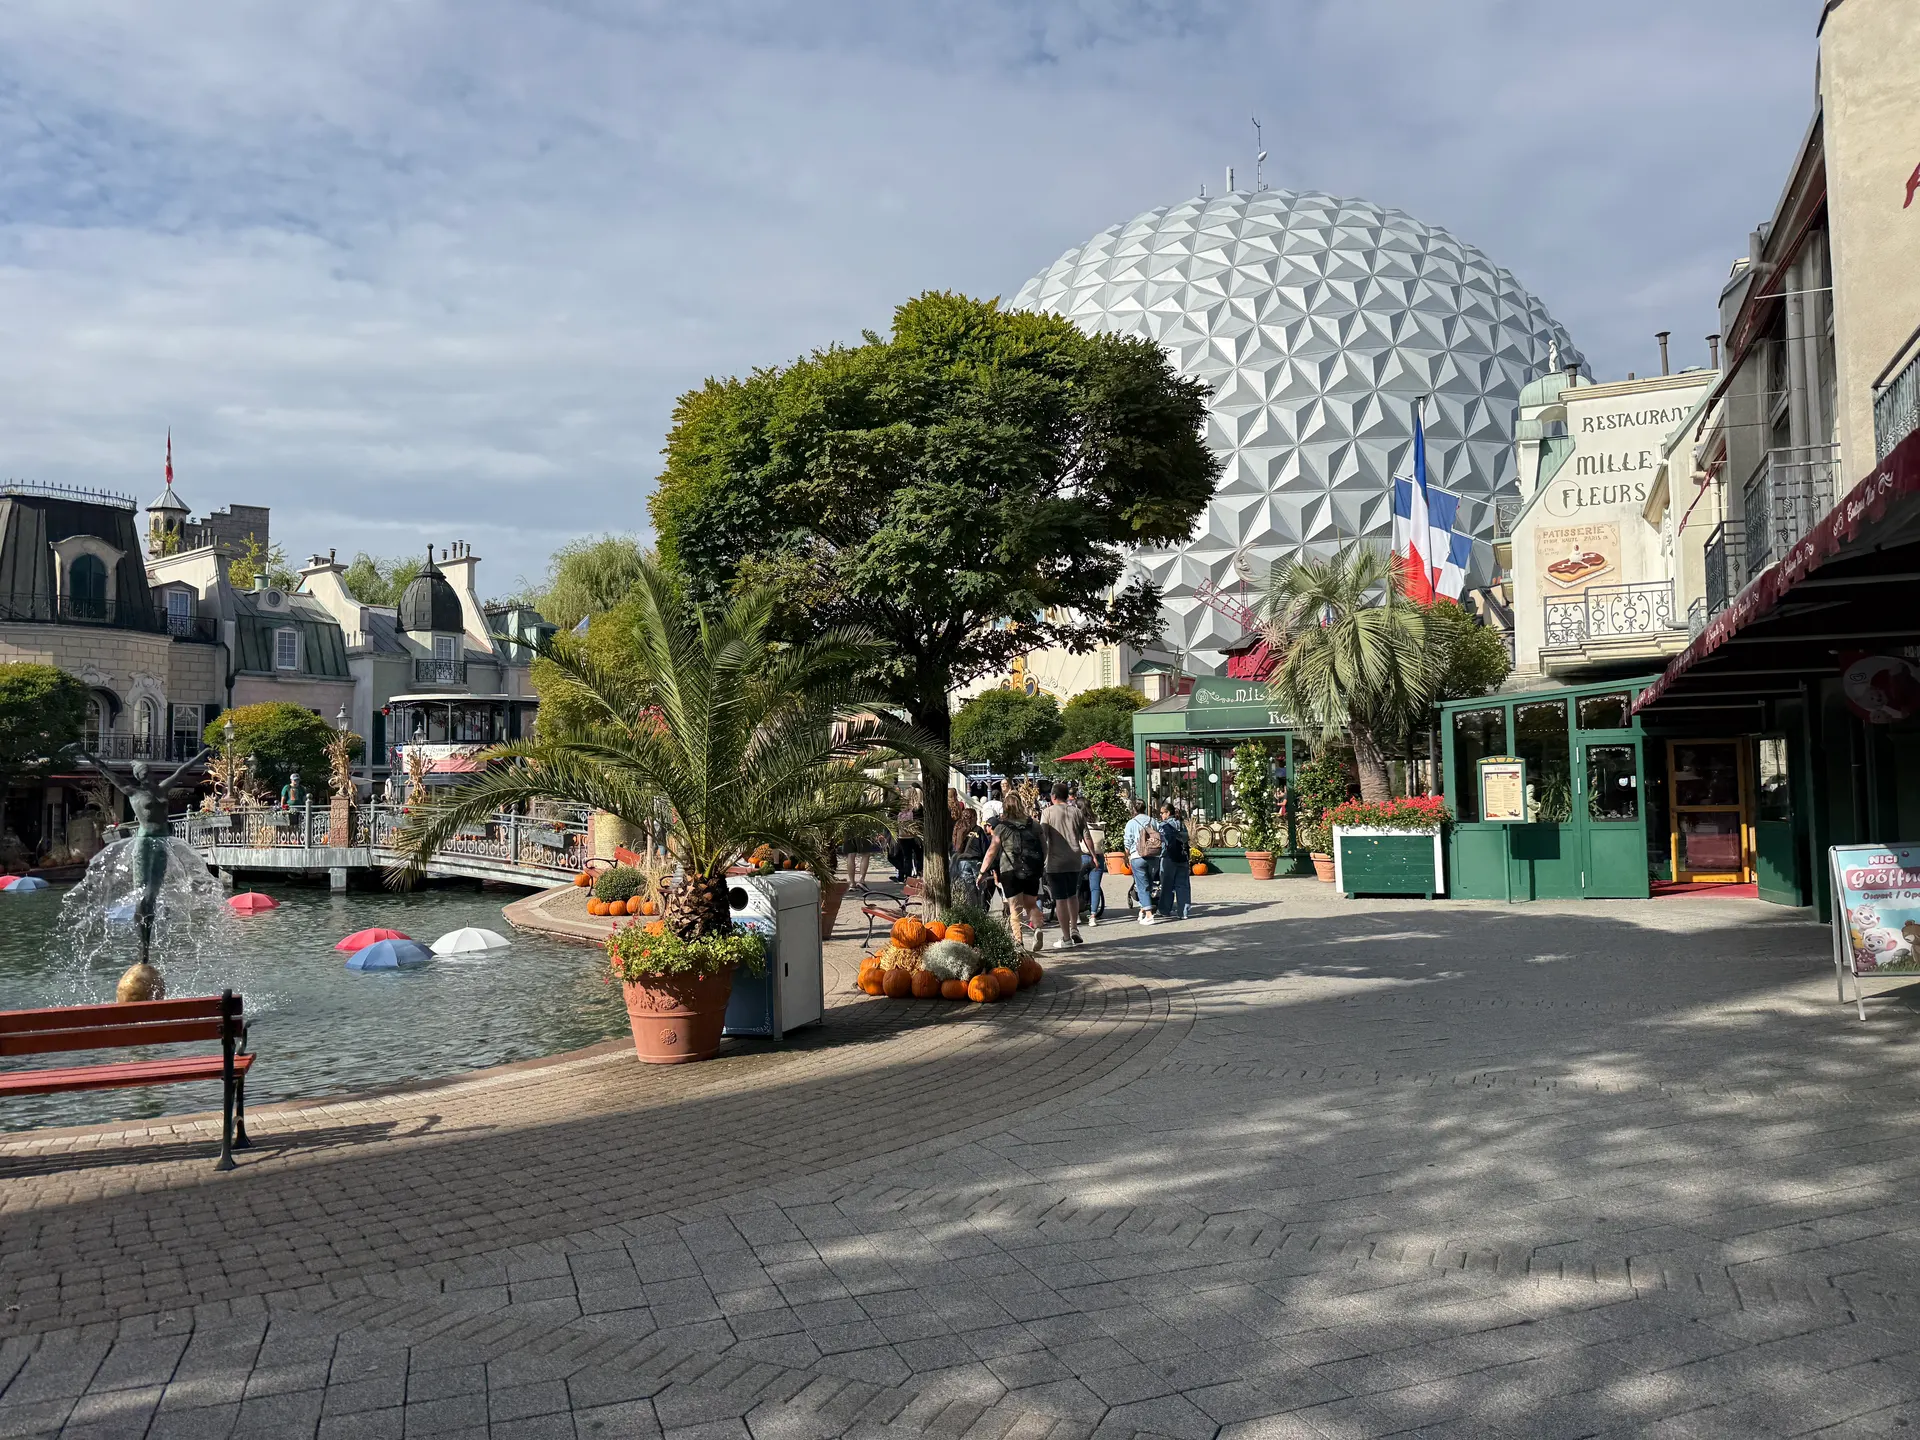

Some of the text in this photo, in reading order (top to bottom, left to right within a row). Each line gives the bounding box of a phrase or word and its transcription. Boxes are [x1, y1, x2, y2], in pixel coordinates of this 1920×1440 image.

[1576, 450, 1653, 476] MILLE
[1562, 482, 1647, 509] FLEURS
[1543, 526, 1604, 539] PATISSERIE
[1868, 855, 1898, 865] NICI
